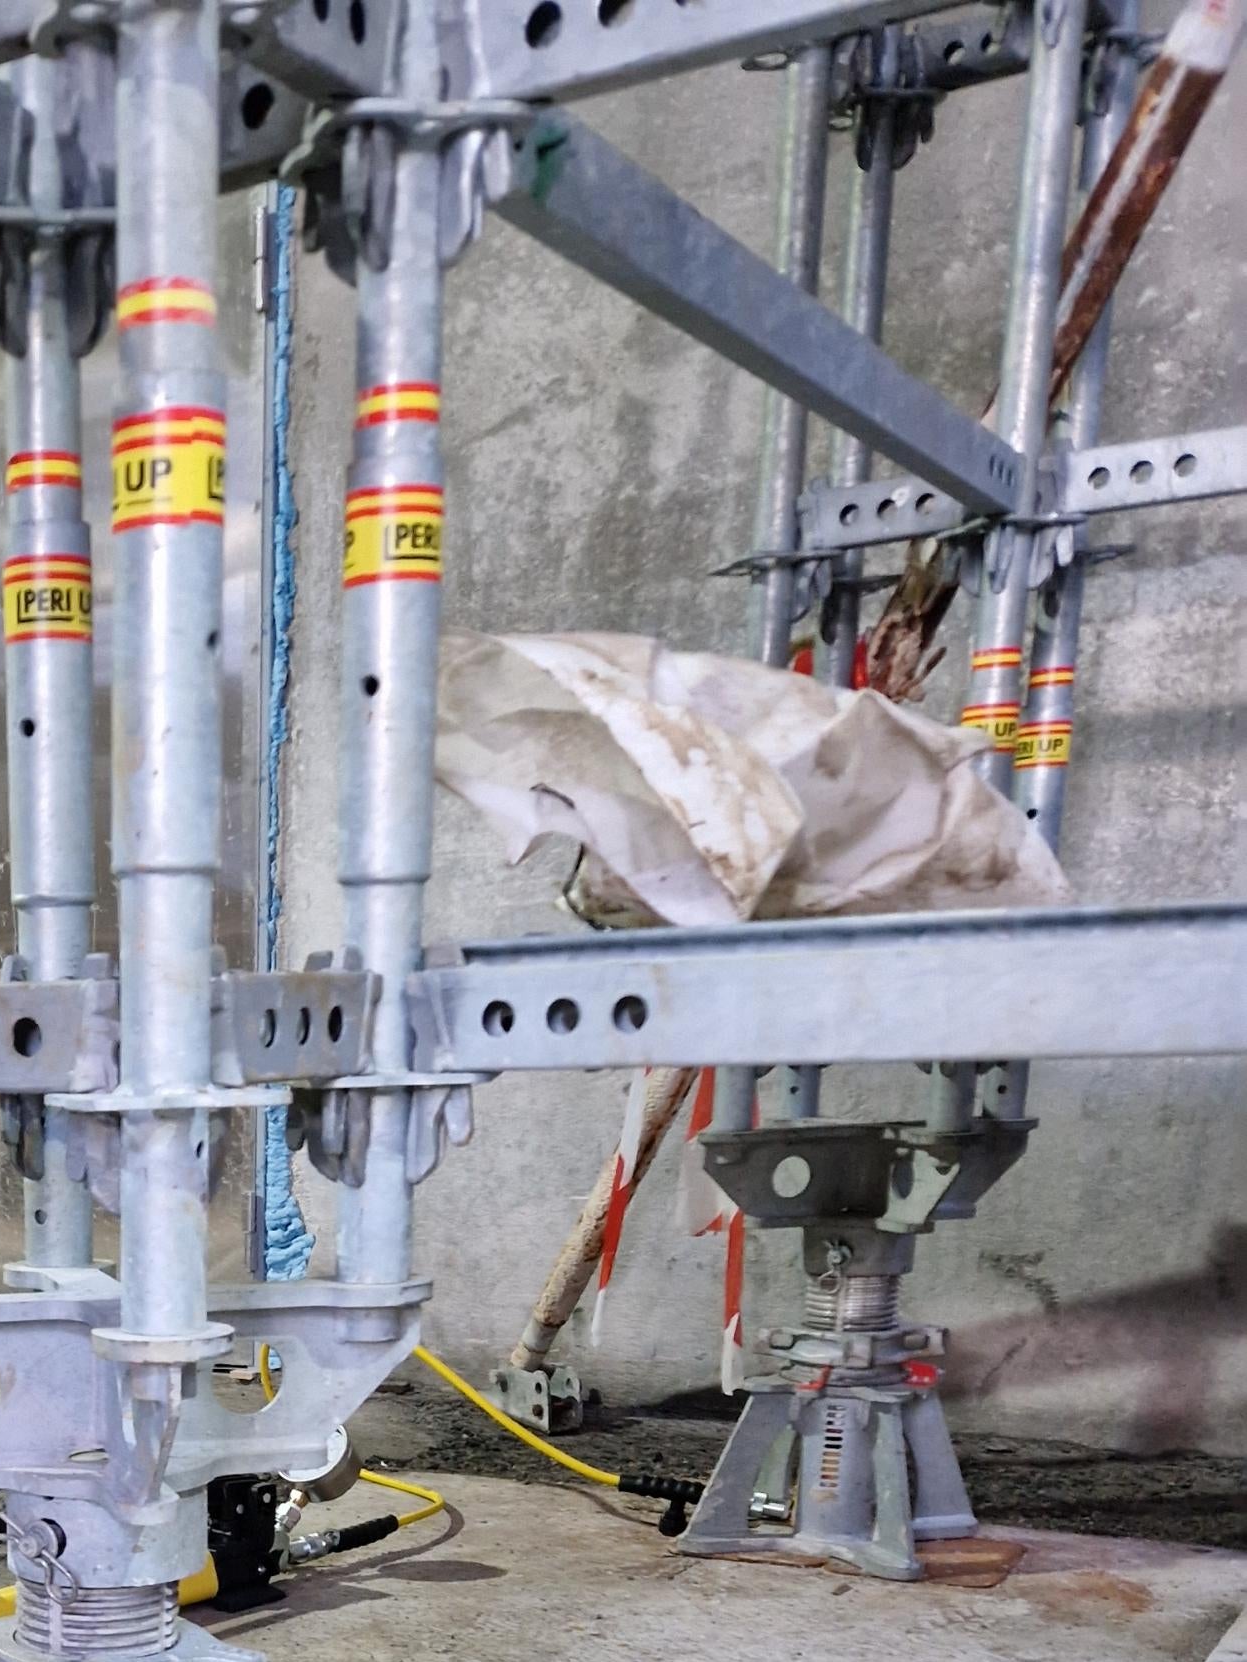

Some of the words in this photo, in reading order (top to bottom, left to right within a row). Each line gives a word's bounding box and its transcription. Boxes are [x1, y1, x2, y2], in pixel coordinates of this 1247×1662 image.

[125, 457, 172, 492] UP
[24, 588, 71, 613] PERI
[79, 590, 92, 614] U
[1039, 738, 1063, 752] UP
